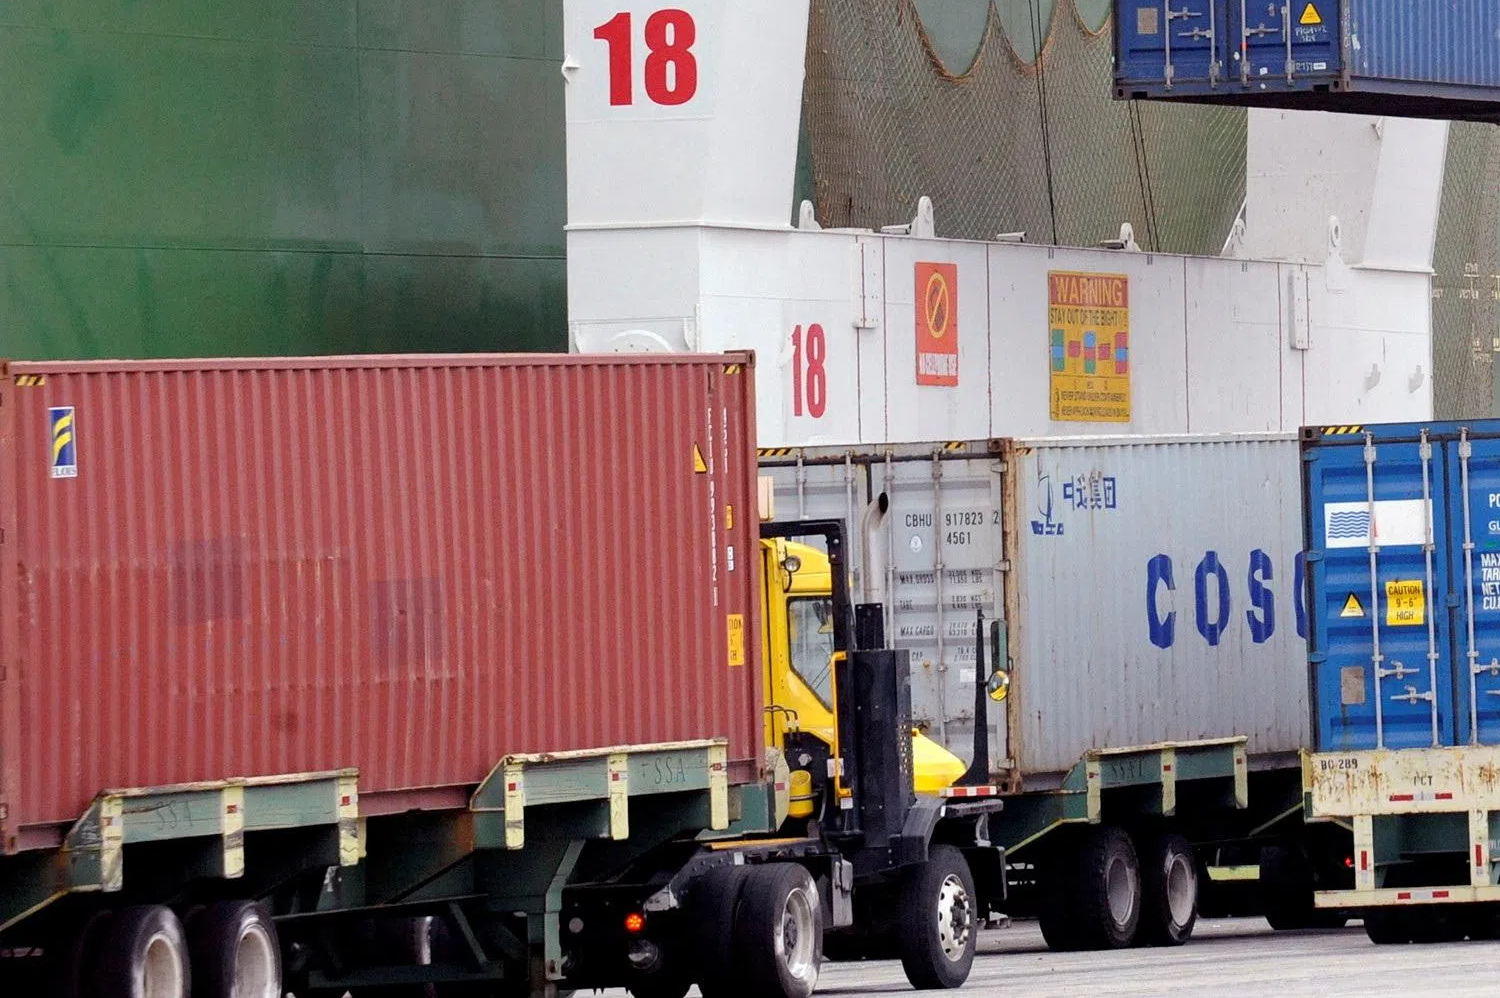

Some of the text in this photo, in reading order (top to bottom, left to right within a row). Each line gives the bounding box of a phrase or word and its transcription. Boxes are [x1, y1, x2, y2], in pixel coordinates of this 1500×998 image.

[594, 9, 697, 106] 18
[1055, 276, 1122, 306] WARNING
[1050, 308, 1066, 324] STAY
[1067, 309, 1079, 325] OUT
[1080, 310, 1089, 325] OF
[1089, 310, 1100, 326] THE
[792, 323, 826, 418] 18
[905, 511, 999, 527] CBHU 917823 2
[946, 532, 971, 545] 45G1
[1388, 584, 1420, 595] CAUTION
[1482, 582, 1500, 595] NET
[1396, 611, 1414, 621] HIGH
[1338, 758, 1358, 769] 289
